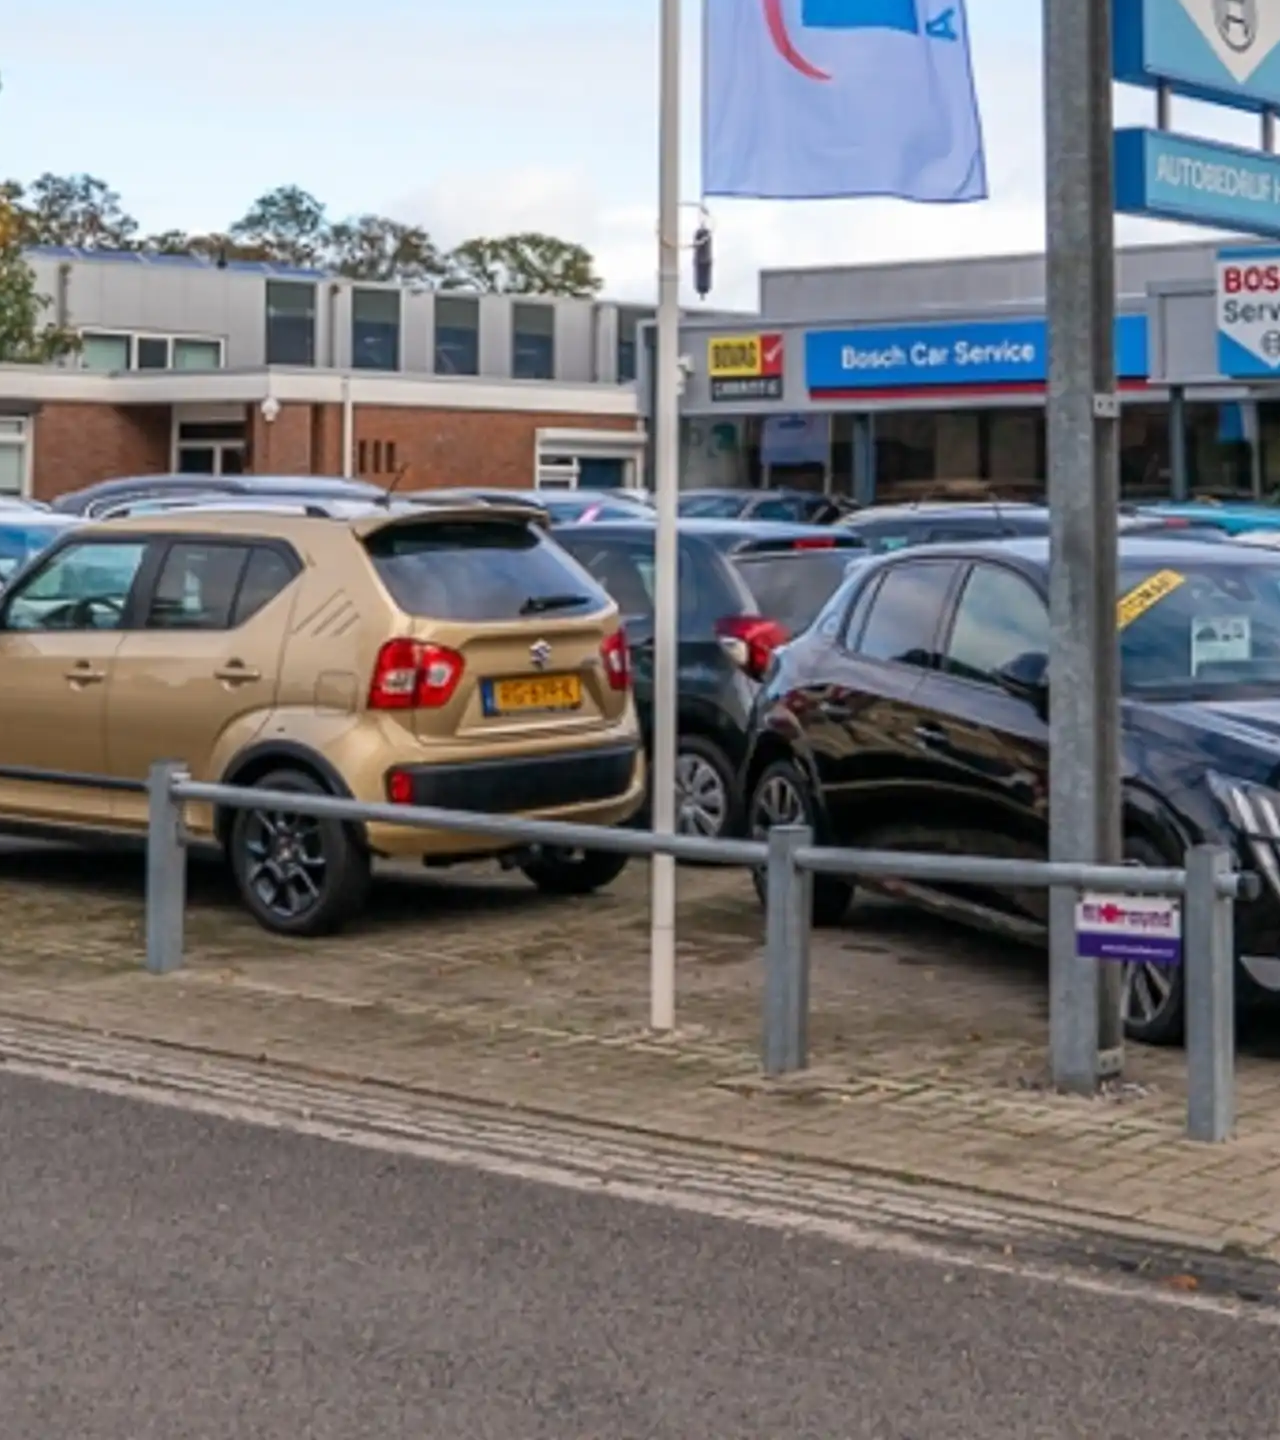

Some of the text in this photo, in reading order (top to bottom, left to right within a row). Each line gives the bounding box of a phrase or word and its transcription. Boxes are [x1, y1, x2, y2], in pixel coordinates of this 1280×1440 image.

[1155, 153, 1272, 202] AUTOBEDRIJF
[841, 338, 1036, 370] Bosch Car Service
